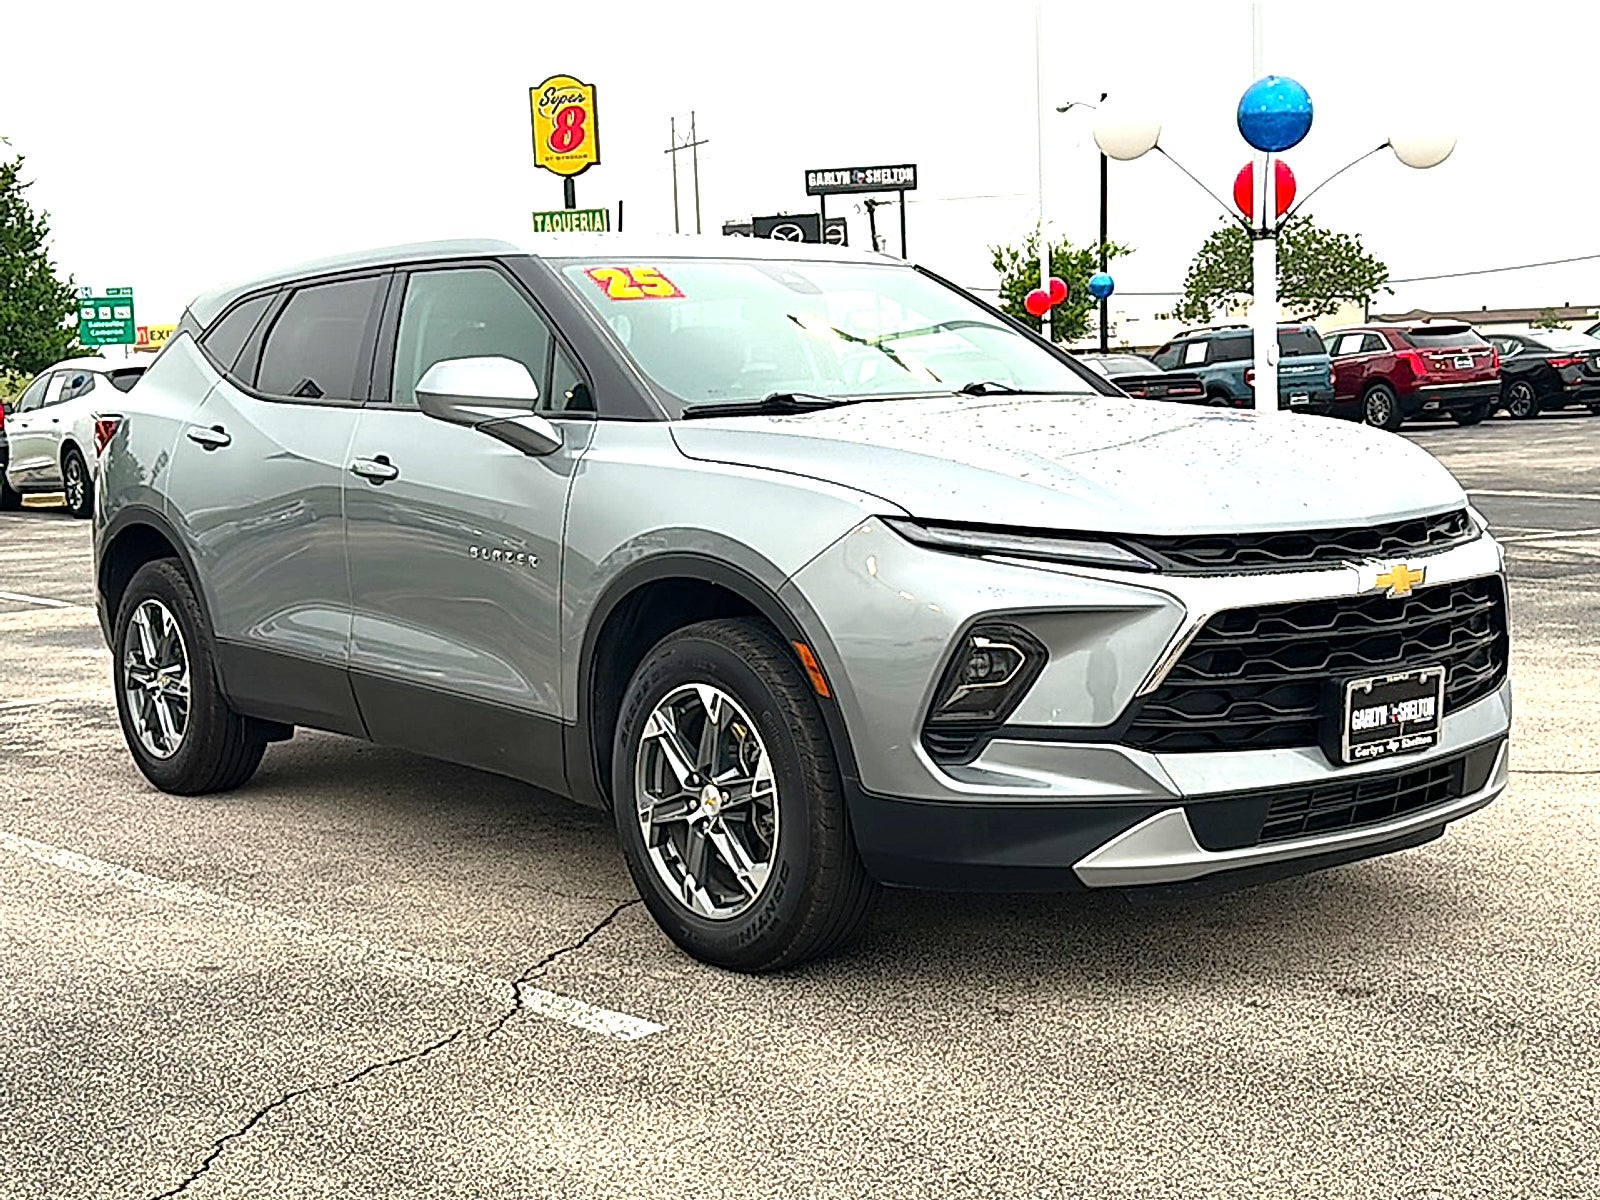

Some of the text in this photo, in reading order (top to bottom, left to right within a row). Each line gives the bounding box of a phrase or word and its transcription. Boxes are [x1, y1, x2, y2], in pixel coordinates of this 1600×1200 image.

[539, 87, 586, 114] Super
[549, 105, 587, 154] 8
[808, 168, 914, 186] GARLYN SHELTON
[534, 212, 605, 232] TAQUERIA
[590, 267, 674, 298] 25
[150, 329, 174, 341] EXI
[469, 545, 539, 569] BLAZER
[1352, 697, 1435, 730] GARLYN SHELTON
